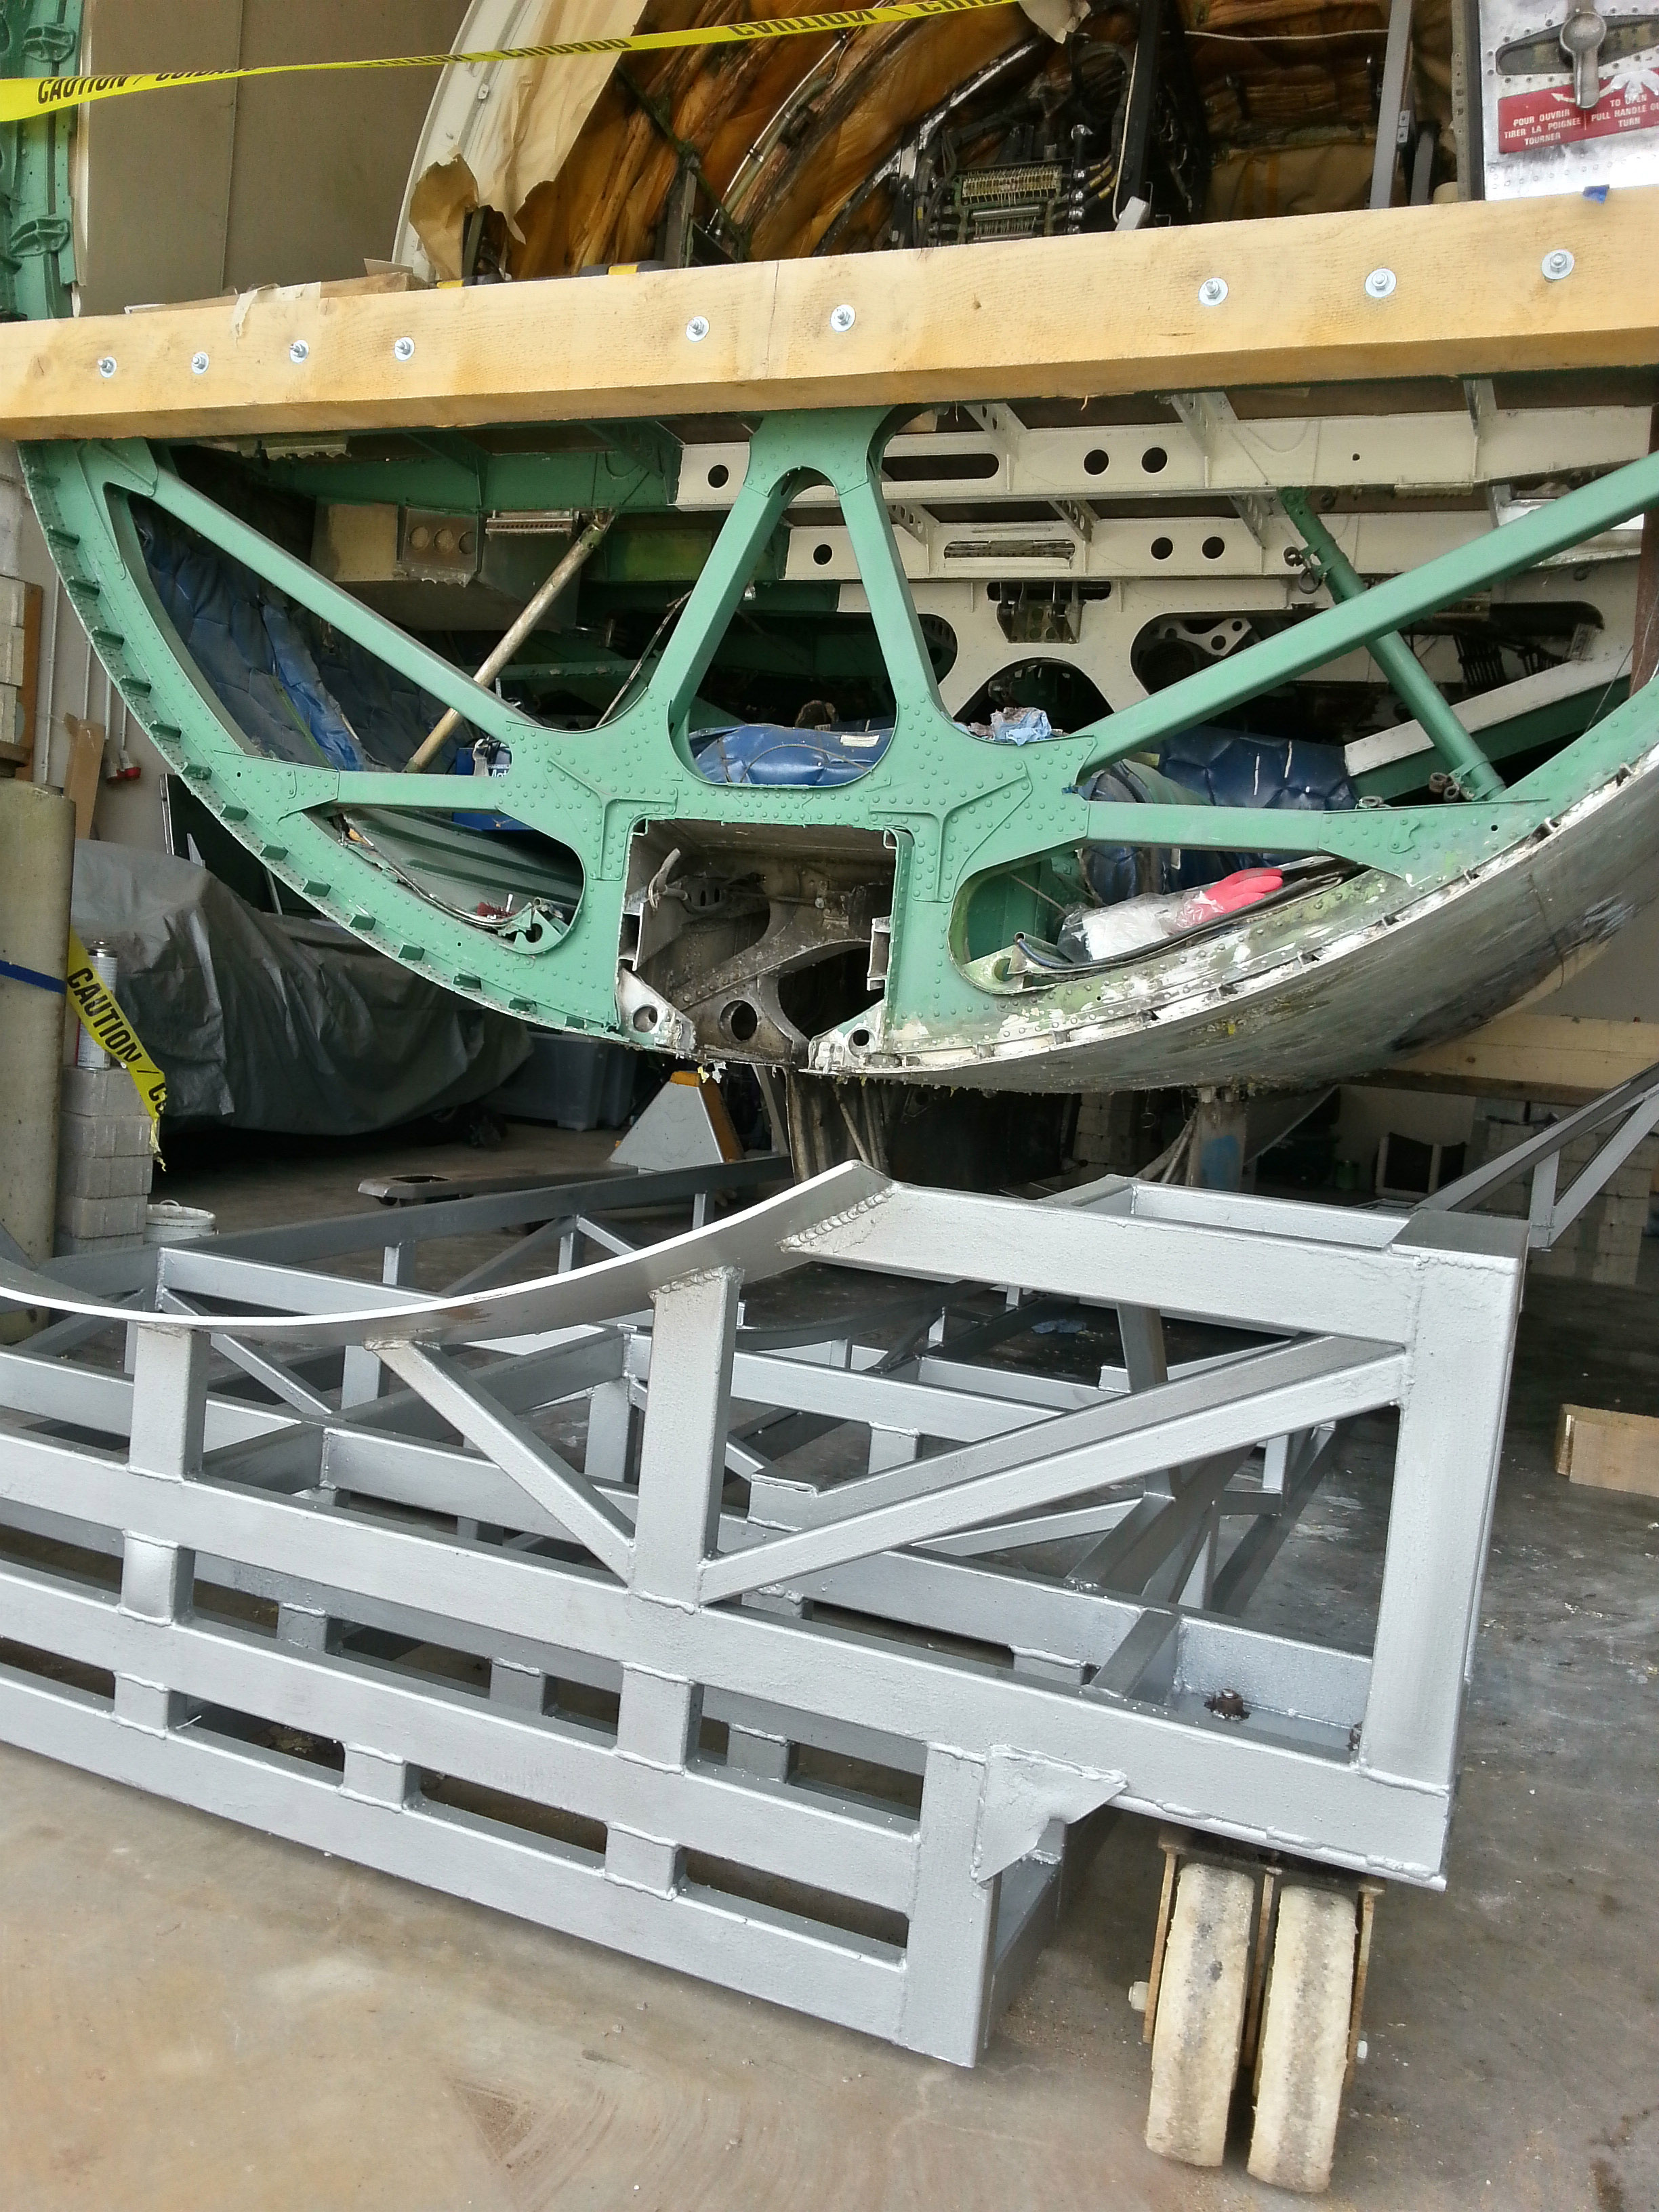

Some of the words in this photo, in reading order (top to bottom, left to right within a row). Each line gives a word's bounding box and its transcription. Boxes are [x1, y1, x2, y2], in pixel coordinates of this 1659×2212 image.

[37, 76, 130, 104] CAUTION
[1610, 99, 1621, 107] TO
[1624, 94, 1647, 105] OPEN
[1513, 115, 1534, 127] POUR
[1539, 108, 1570, 122] OUVRIR
[1591, 112, 1611, 122] PULL
[1614, 104, 1647, 117] HANDLE
[1532, 125, 1542, 134] LA
[1618, 117, 1641, 127] TURN
[1523, 132, 1561, 145] TOURNER
[68, 967, 143, 1064] CAUTION
